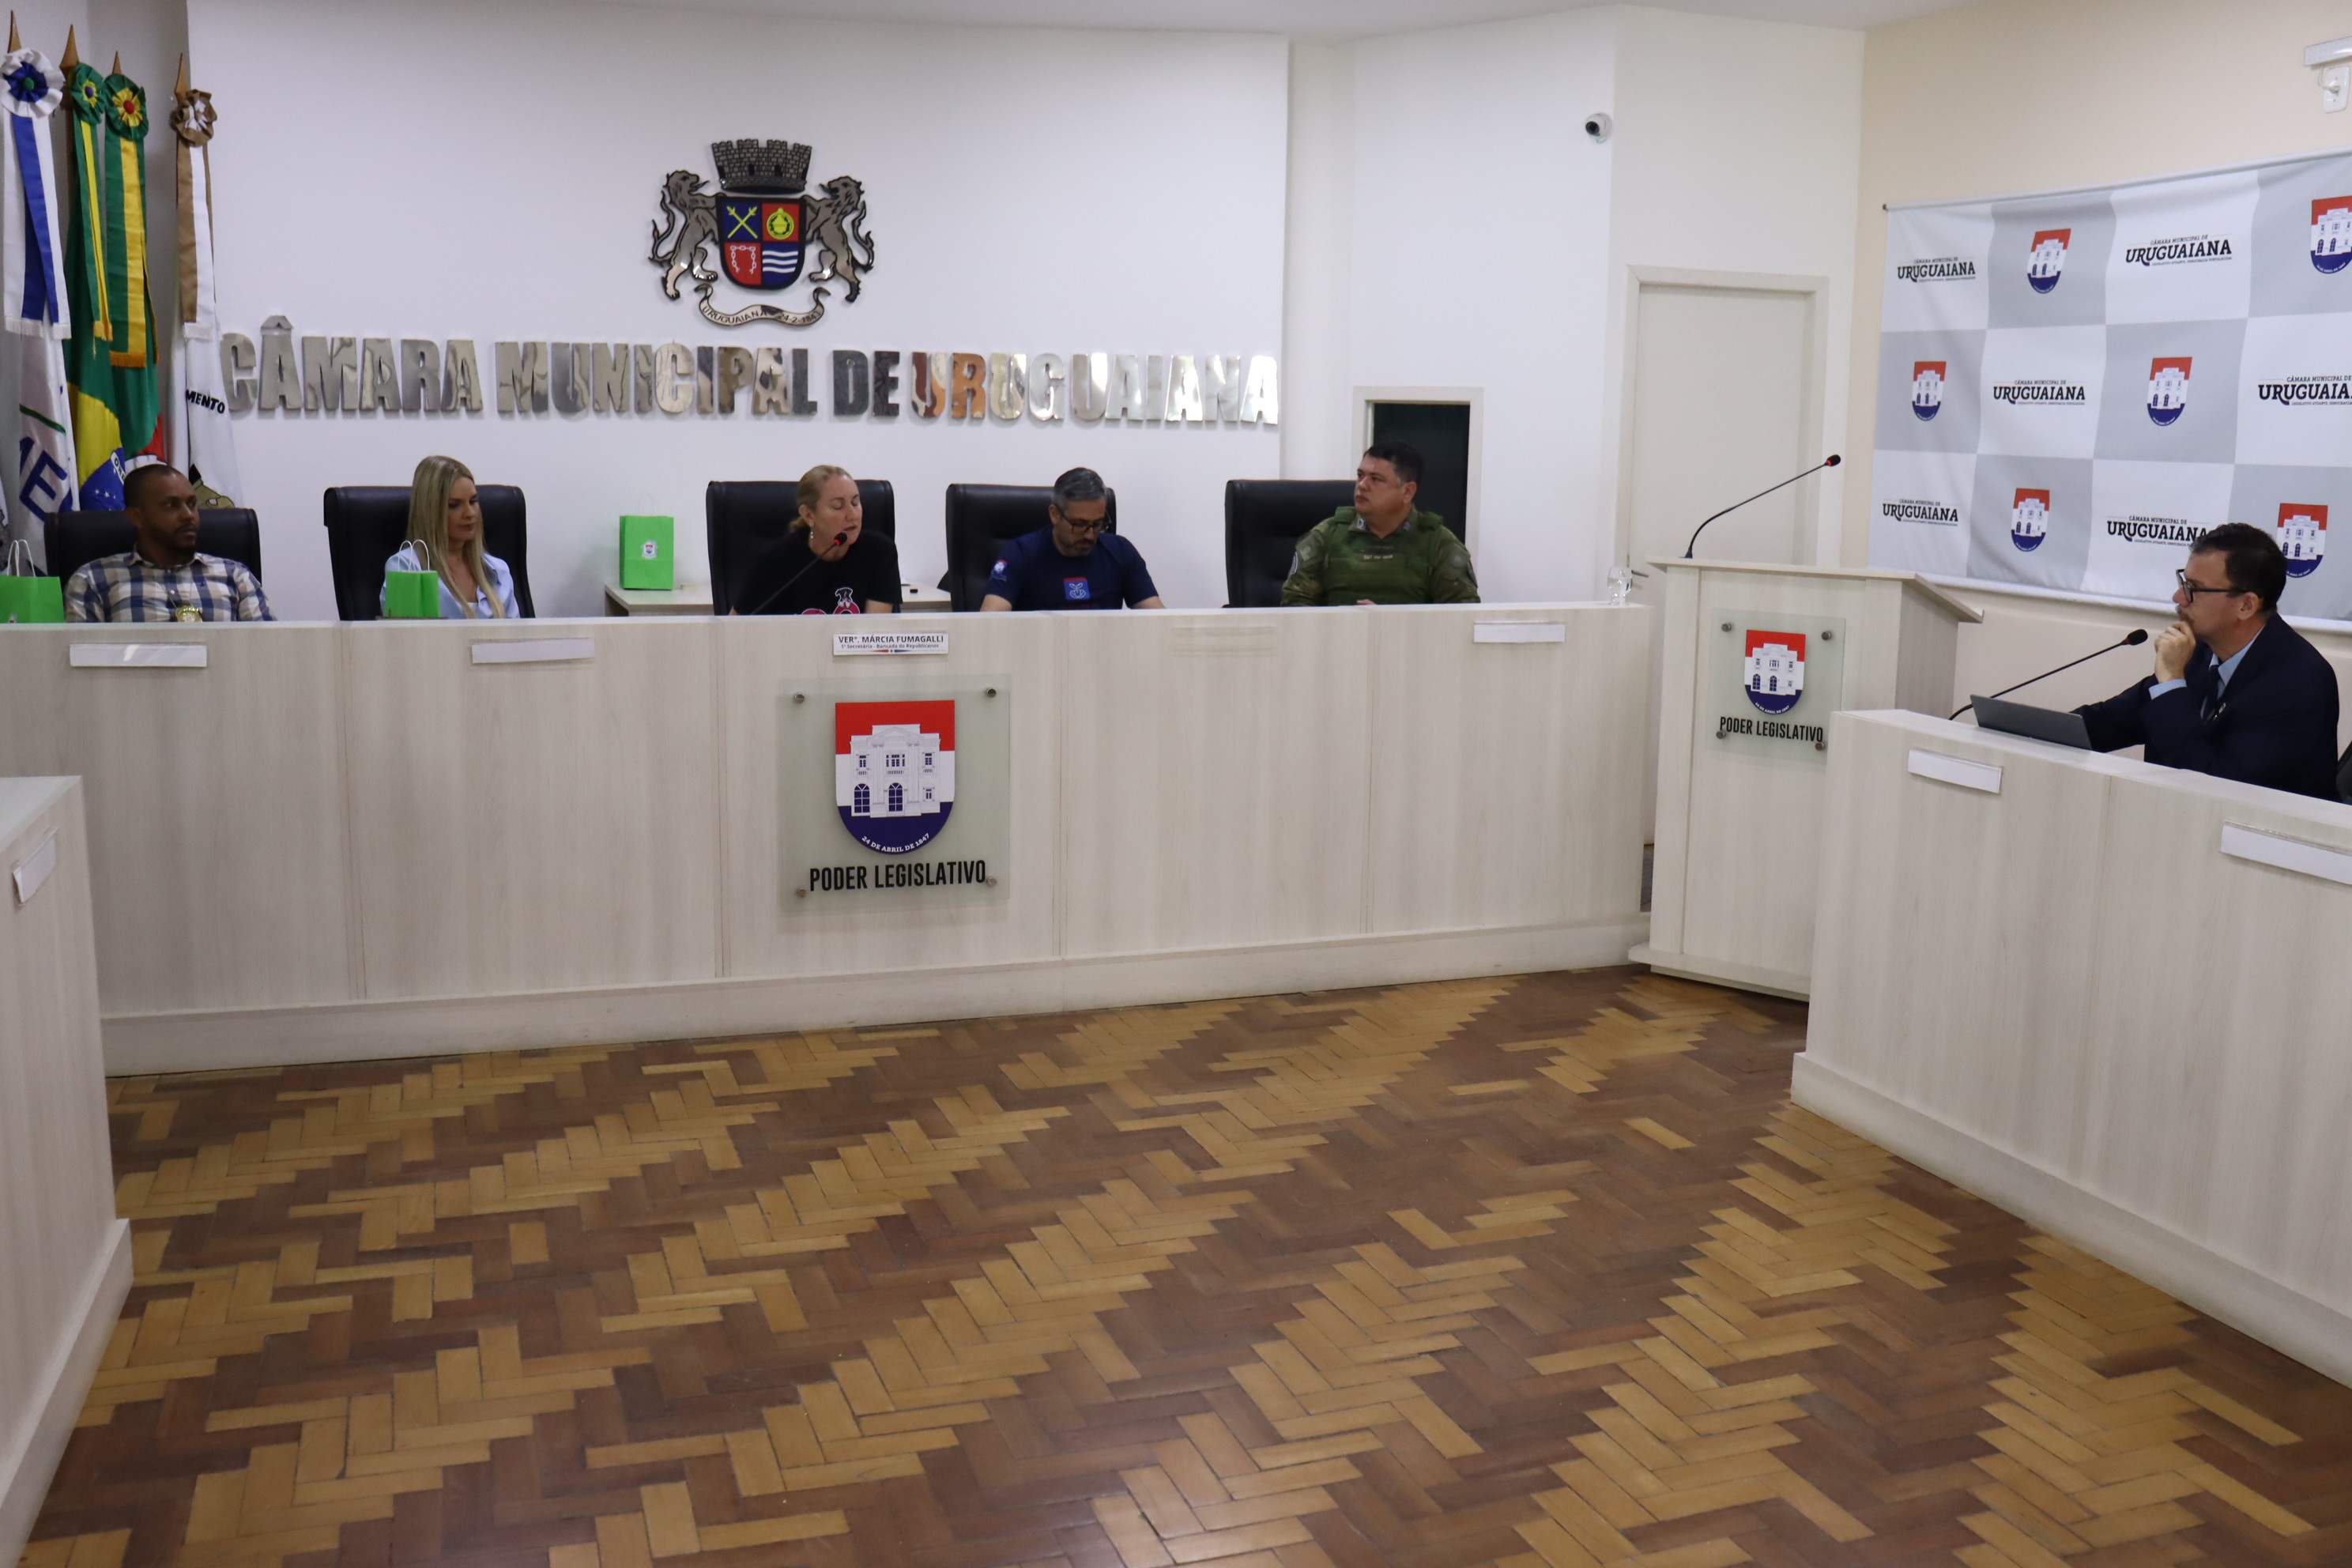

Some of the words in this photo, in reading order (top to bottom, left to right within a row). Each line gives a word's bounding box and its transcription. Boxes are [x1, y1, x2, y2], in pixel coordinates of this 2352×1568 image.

[2126, 239, 2232, 266] URUGUAIANA
[1898, 262, 1976, 282] URUGUAIANA
[702, 306, 767, 323] URUGUAIANA
[221, 315, 483, 412] CÂMARA
[495, 340, 818, 416] MUNICIPAL
[832, 349, 900, 416] DE
[911, 352, 1279, 424] URUGUAIANA
[1993, 386, 2085, 405] URUGUAIANA
[1883, 503, 1958, 522] URUGUAIANA
[862, 634, 895, 643] MÁRCIA
[1720, 717, 1753, 734] PODER
[1756, 721, 1823, 742] LEGISLATIVO
[861, 836, 870, 845] 24
[915, 832, 929, 846] 1847
[810, 866, 868, 891] PODER
[875, 860, 986, 888] LEGISLATIVO
